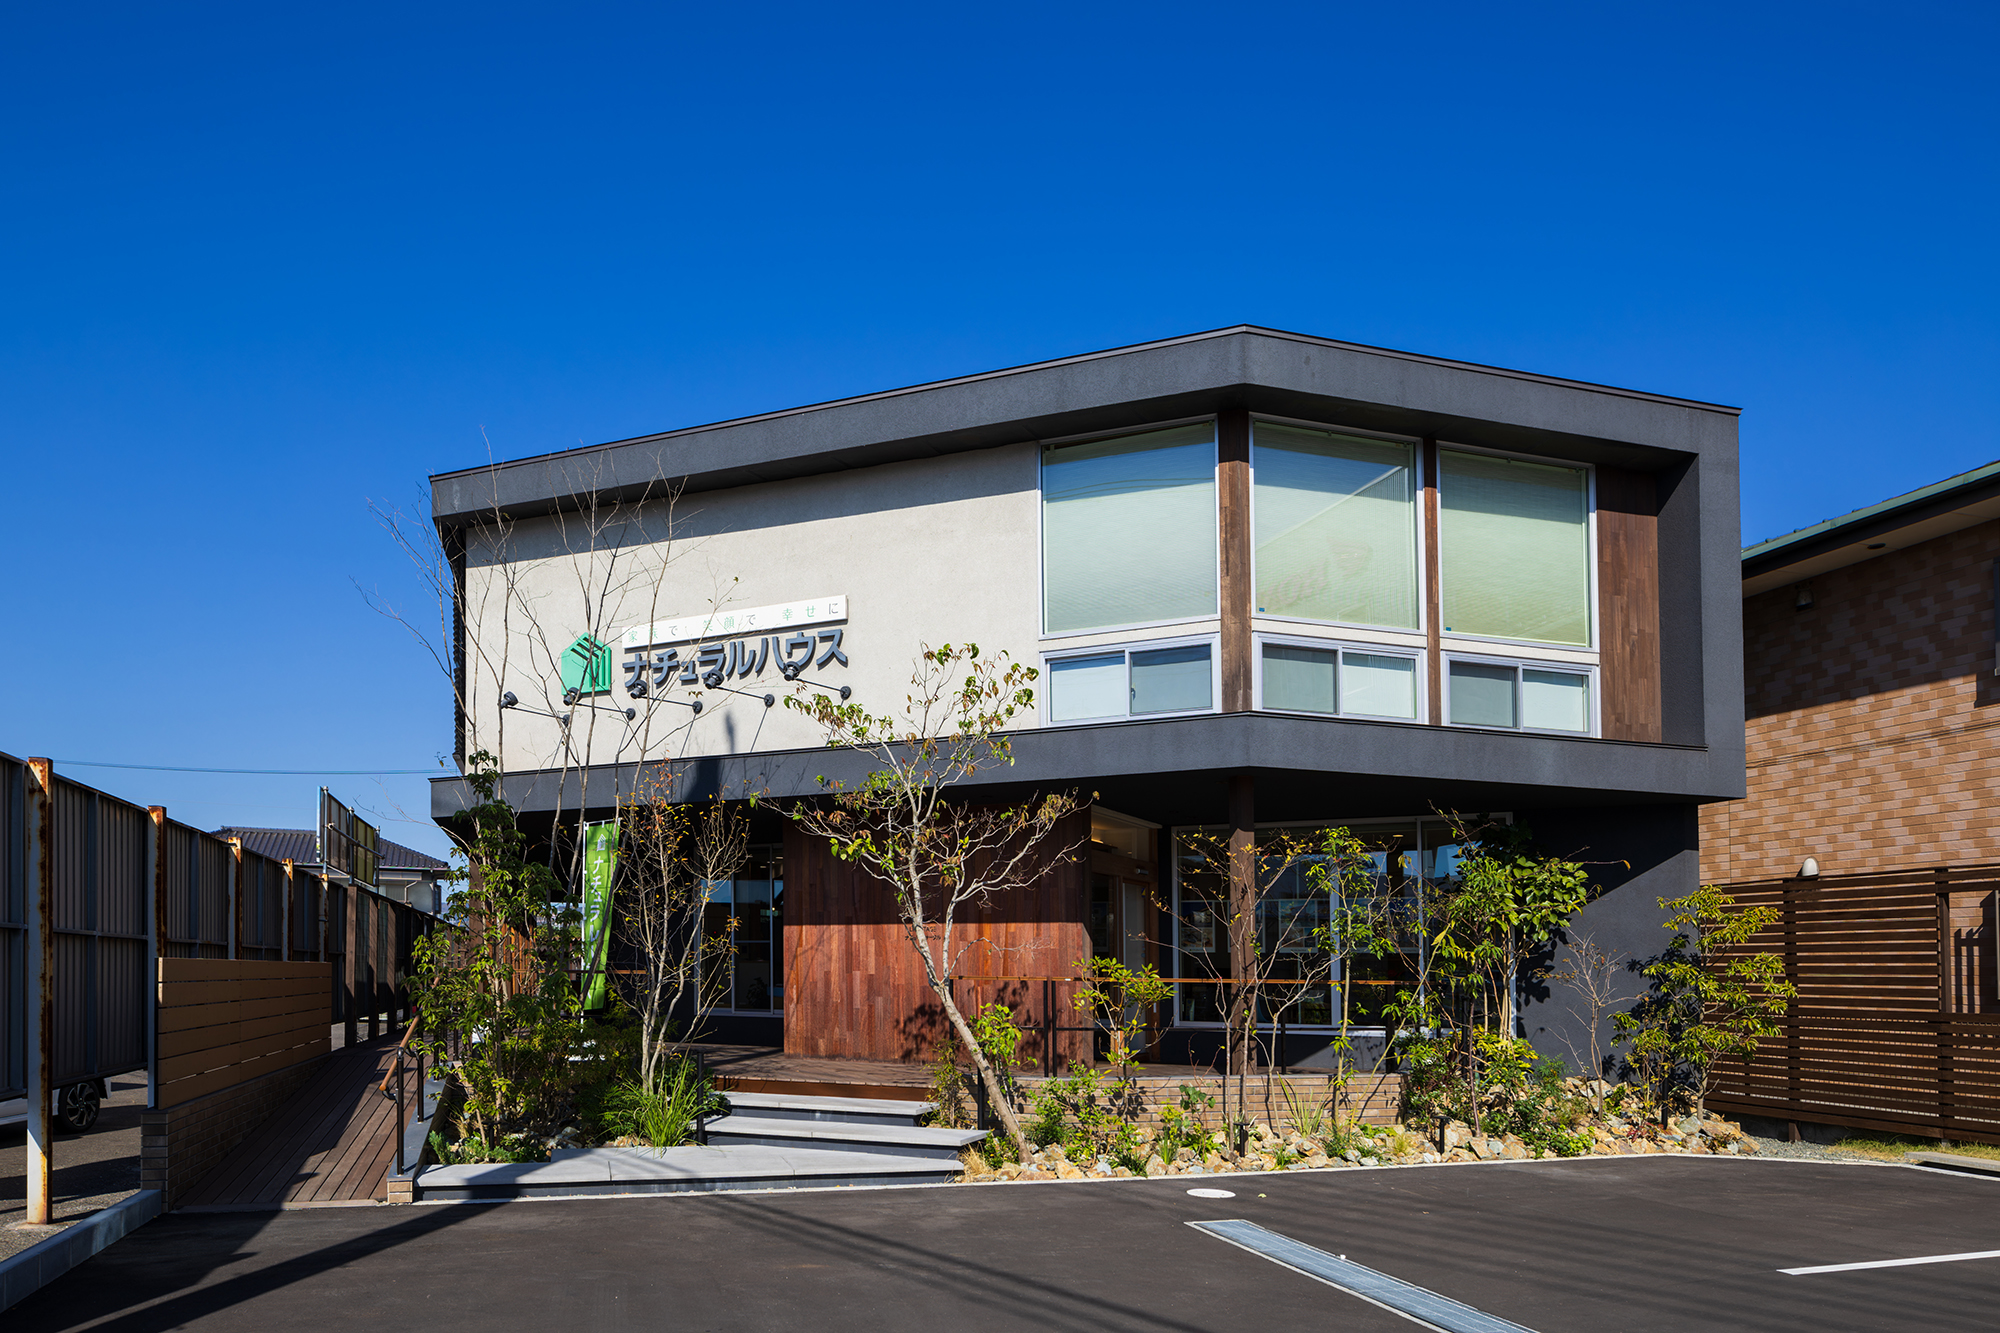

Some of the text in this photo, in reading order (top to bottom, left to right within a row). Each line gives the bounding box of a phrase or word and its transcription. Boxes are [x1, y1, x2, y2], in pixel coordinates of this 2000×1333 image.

[782, 602, 839, 621] 幸せに
[622, 628, 848, 688] ナチュラルハウス
[585, 856, 604, 999] ナチュラル
